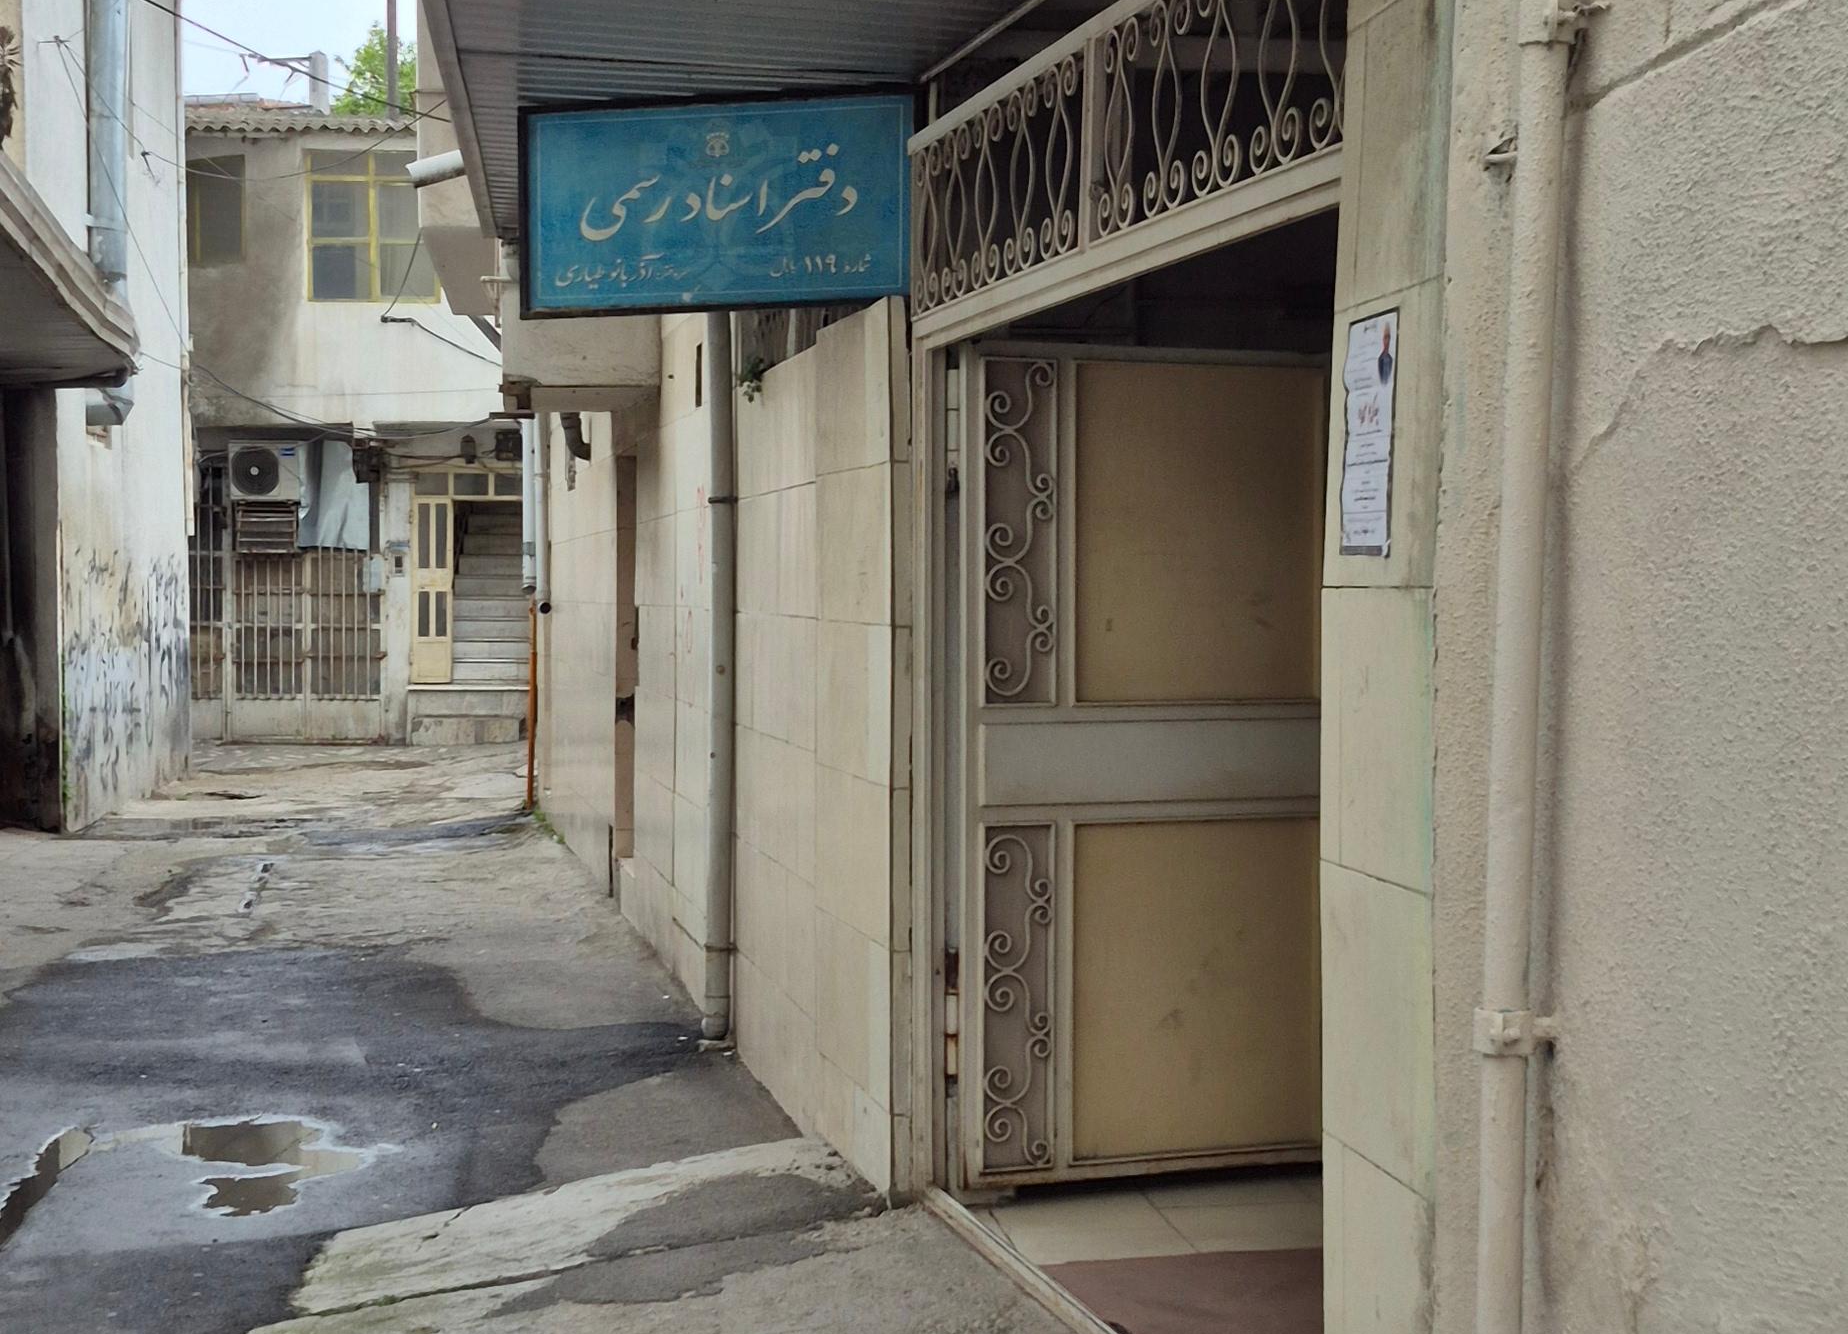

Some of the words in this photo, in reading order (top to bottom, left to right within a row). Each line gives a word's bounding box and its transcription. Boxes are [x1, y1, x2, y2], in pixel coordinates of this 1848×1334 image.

[579, 174, 672, 242] رسمی
[680, 173, 768, 223] اسناد
[755, 142, 859, 235] دفتر
[803, 254, 837, 274] ۱۱۹
